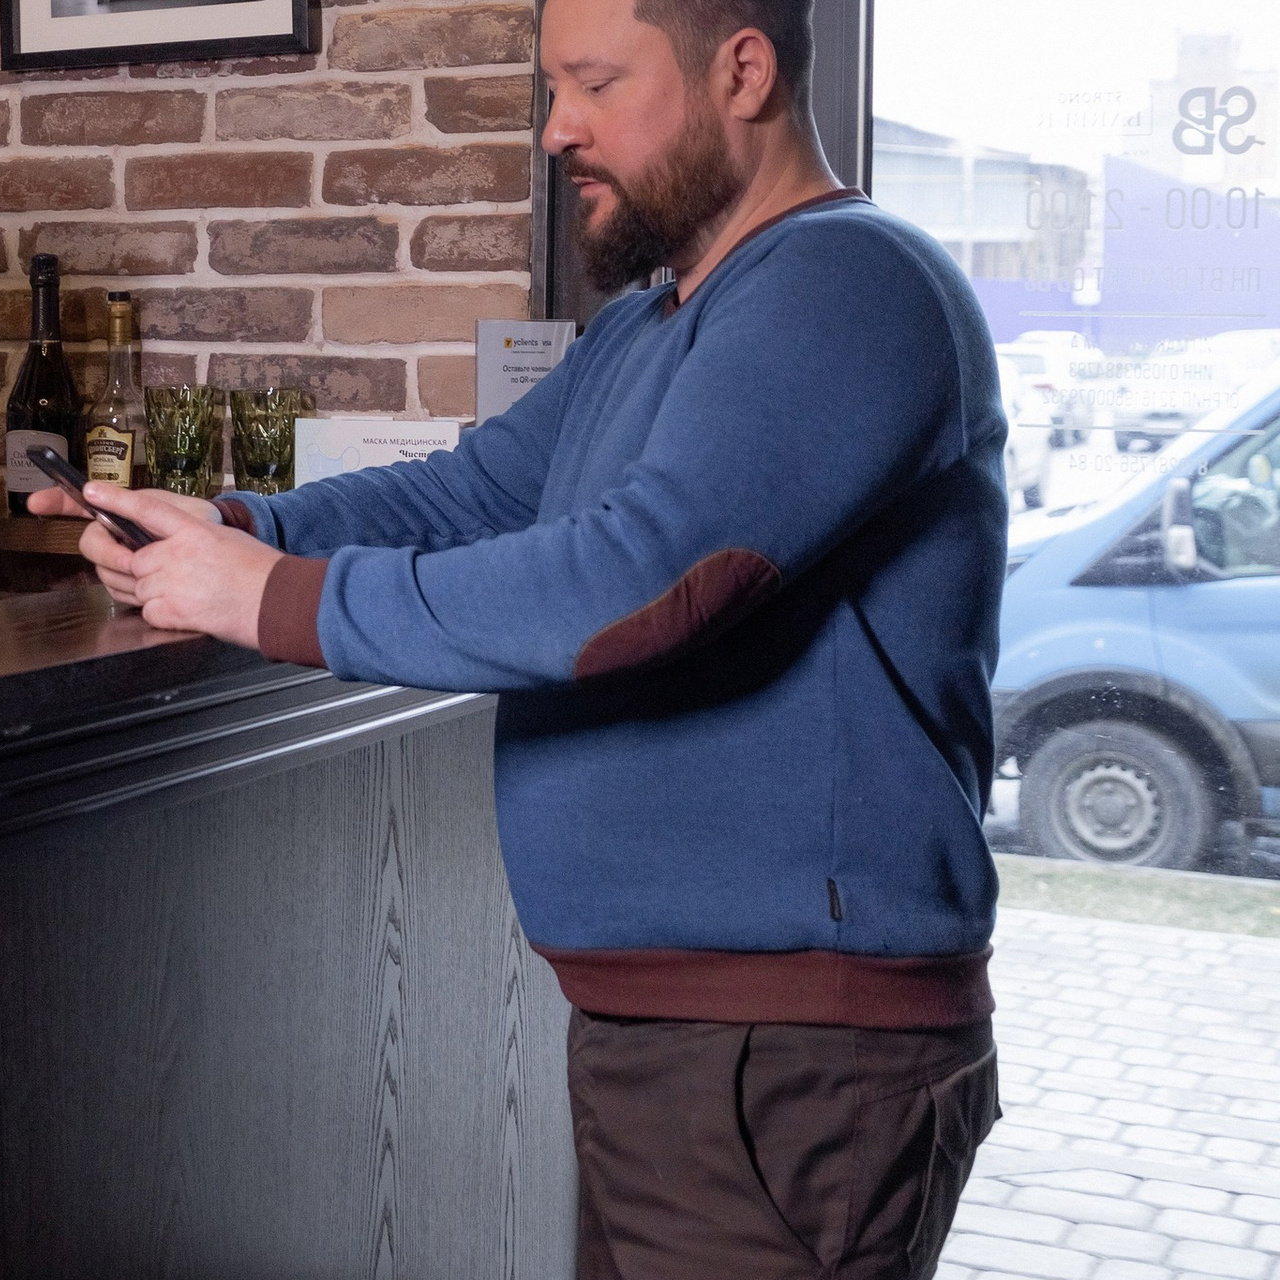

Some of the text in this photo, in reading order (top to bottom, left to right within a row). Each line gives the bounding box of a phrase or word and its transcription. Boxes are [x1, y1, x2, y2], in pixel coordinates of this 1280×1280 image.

[502, 364, 530, 373] Оставьте
[362, 437, 448, 447] МАСКА МЕДИЦИНСКАЯ
